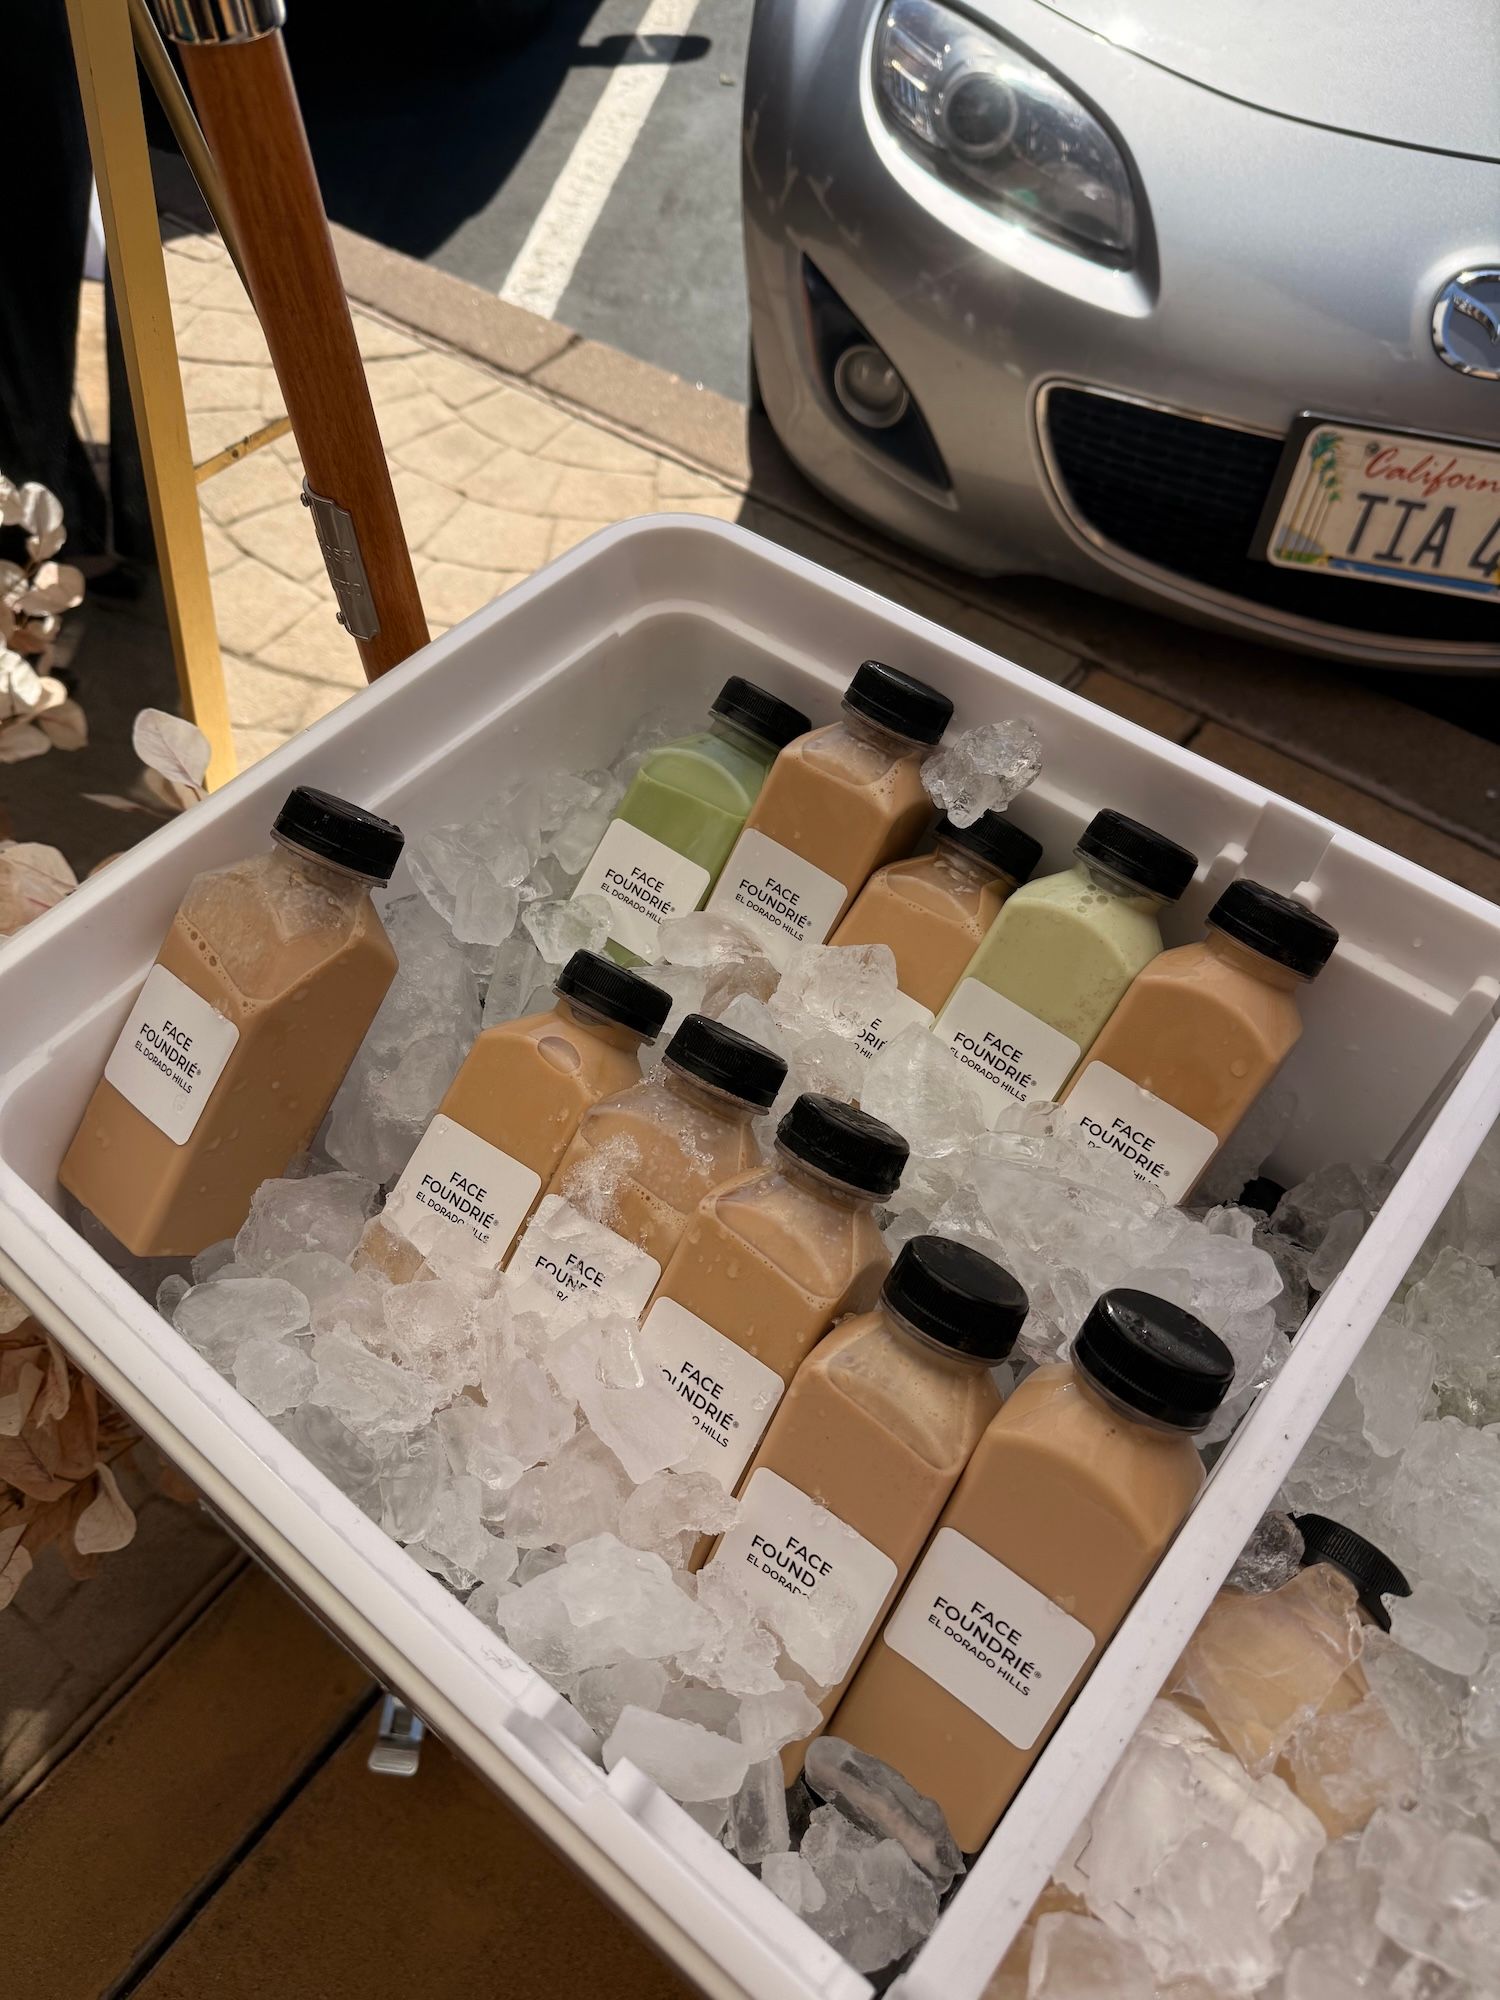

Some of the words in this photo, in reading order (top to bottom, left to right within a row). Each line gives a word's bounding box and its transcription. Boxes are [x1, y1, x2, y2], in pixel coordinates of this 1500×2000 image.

[1346, 493, 1456, 568] TIA
[631, 867, 664, 893] FACE
[765, 877, 800, 906] FACE
[600, 882, 610, 893] EL
[611, 888, 645, 914] DORADO
[645, 910, 663, 925] HILL
[735, 893, 747, 904] EL
[748, 900, 782, 927] DORADO
[782, 923, 804, 942] HILLS
[162, 1020, 193, 1052] FACE
[983, 1032, 1023, 1063] FACE
[134, 1040, 142, 1053] EL
[143, 1047, 172, 1077] DORADO
[171, 1073, 193, 1094] HILLS
[960, 1054, 1000, 1084] DORADO
[1000, 1081, 1027, 1102] HILLS
[1111, 1117, 1156, 1152] FACE
[415, 1191, 426, 1204] EL
[450, 1171, 487, 1203] FACE
[565, 1253, 606, 1287] FACE
[680, 1361, 724, 1400] FACE
[700, 1422, 729, 1448] HILLS
[746, 1553, 759, 1568] EL
[761, 1562, 810, 1600] DORAD
[751, 1534, 816, 1588] FOUND
[786, 1536, 833, 1577] FACE
[970, 1601, 1023, 1646] FACE
[928, 1614, 942, 1629] EL
[944, 1626, 996, 1669] DORADO
[996, 1666, 1031, 1696] HILLS
